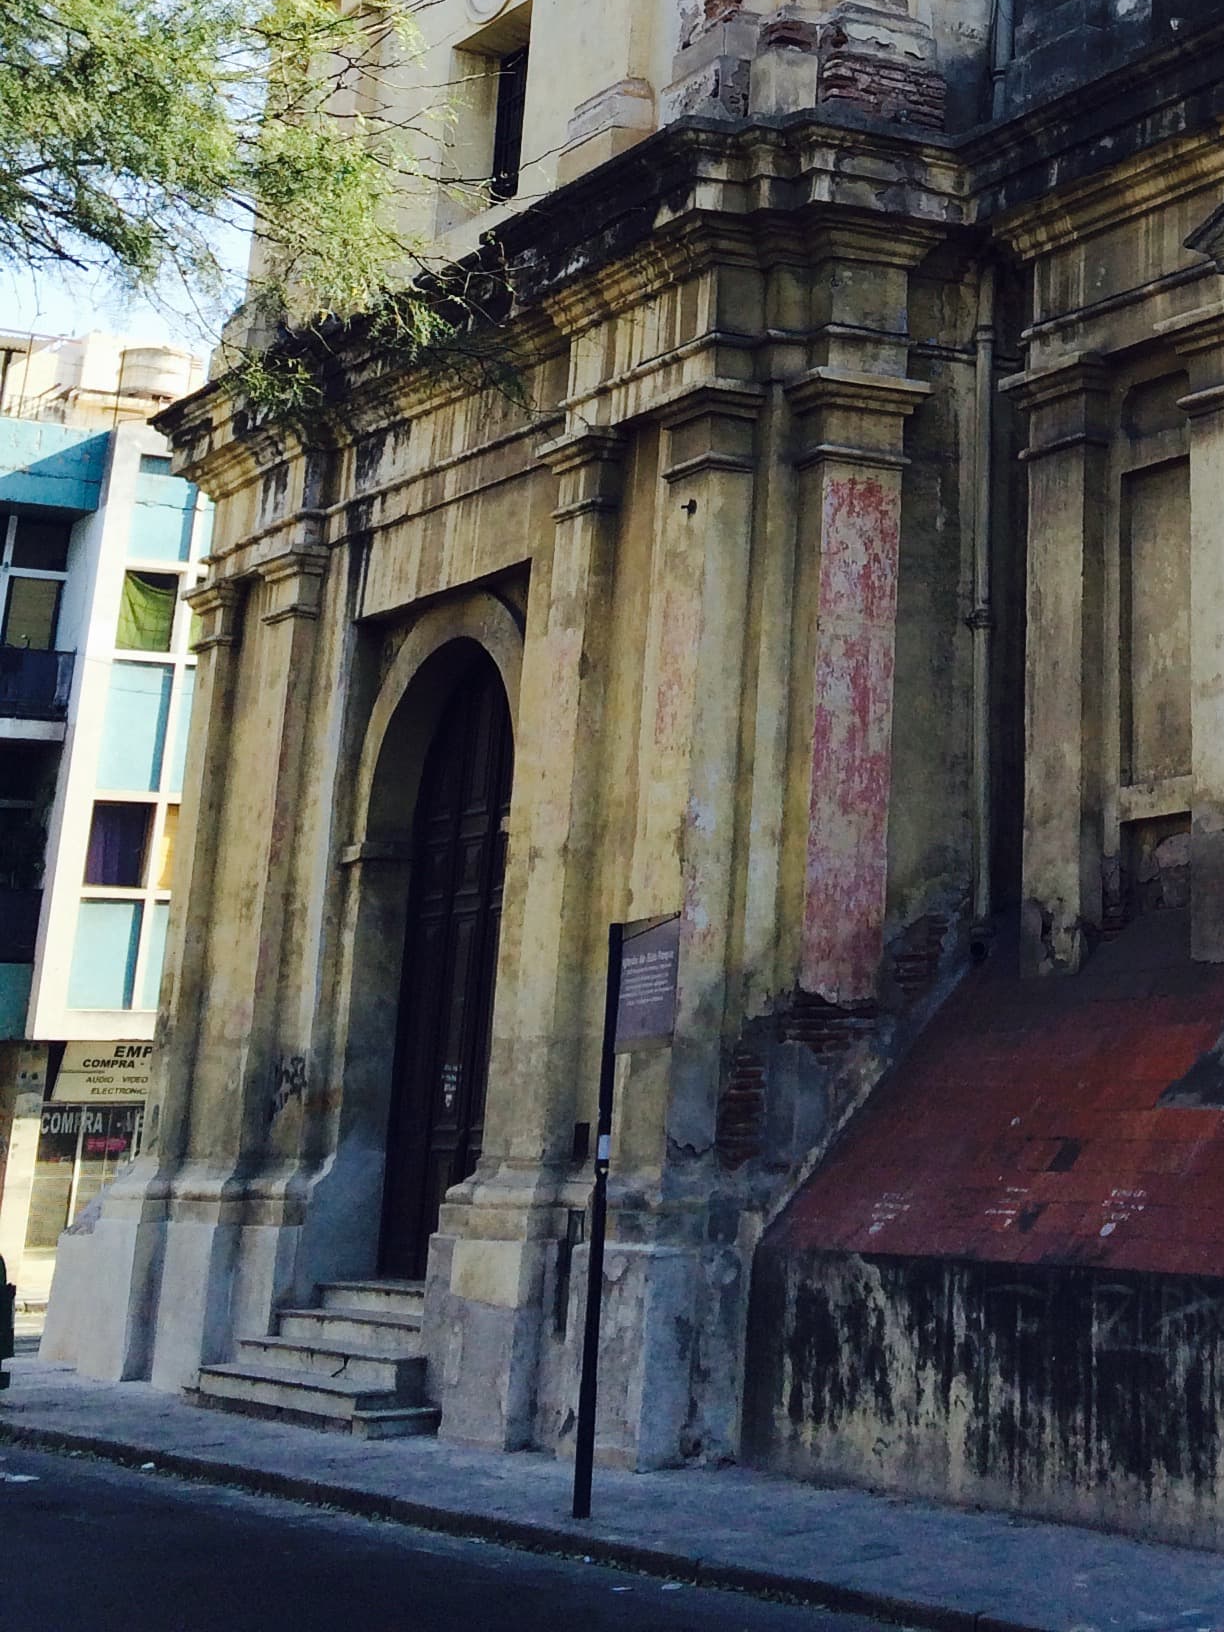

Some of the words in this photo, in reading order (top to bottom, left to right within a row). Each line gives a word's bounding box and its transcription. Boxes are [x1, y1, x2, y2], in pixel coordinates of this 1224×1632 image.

[82, 1059, 135, 1069] COMPRA
[86, 1076, 114, 1084] AUDIO
[122, 1076, 149, 1084] VIDEO
[40, 1111, 103, 1135] COMPRA
